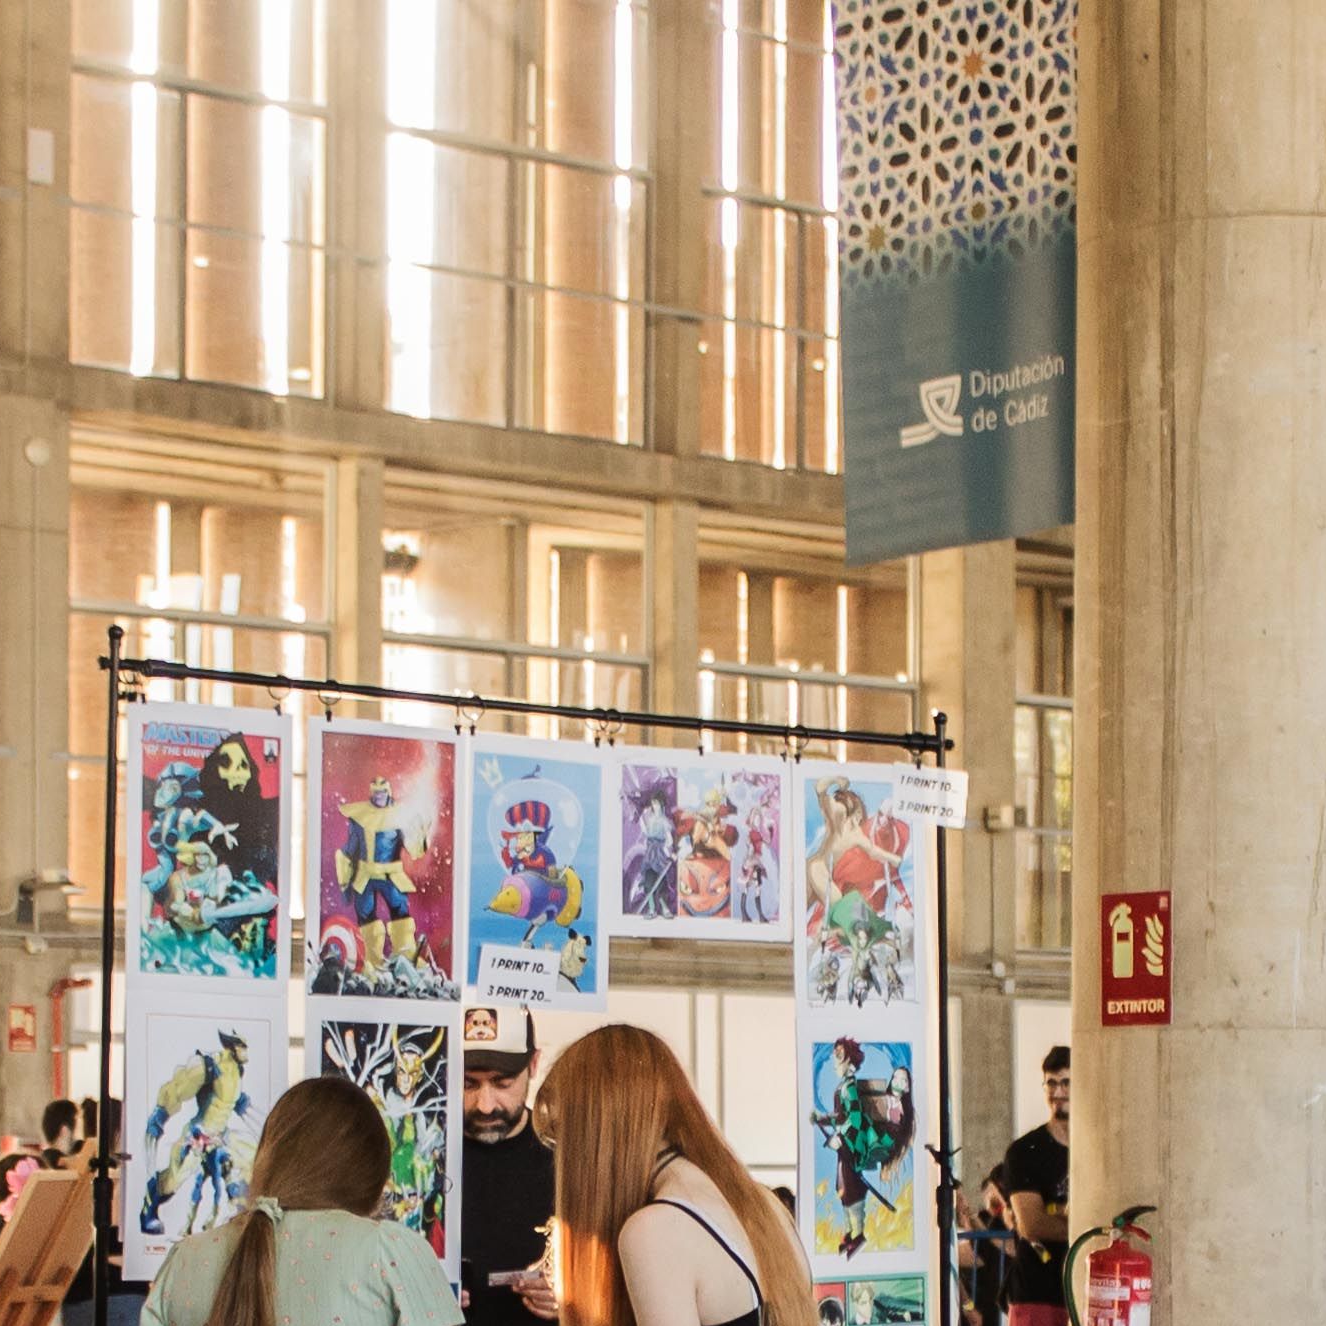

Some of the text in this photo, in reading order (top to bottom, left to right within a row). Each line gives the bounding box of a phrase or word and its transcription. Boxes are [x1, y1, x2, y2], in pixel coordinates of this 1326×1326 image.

[969, 355, 1065, 398] Diputación
[972, 394, 1049, 433] de Cádiz
[162, 746, 181, 757] THE
[906, 776, 938, 790] PRINT
[907, 802, 938, 814] PRINT
[497, 959, 530, 972] PRINT
[487, 985, 494, 996] 3
[496, 986, 528, 999] PRINT
[1108, 999, 1165, 1014] EXTINTOR
